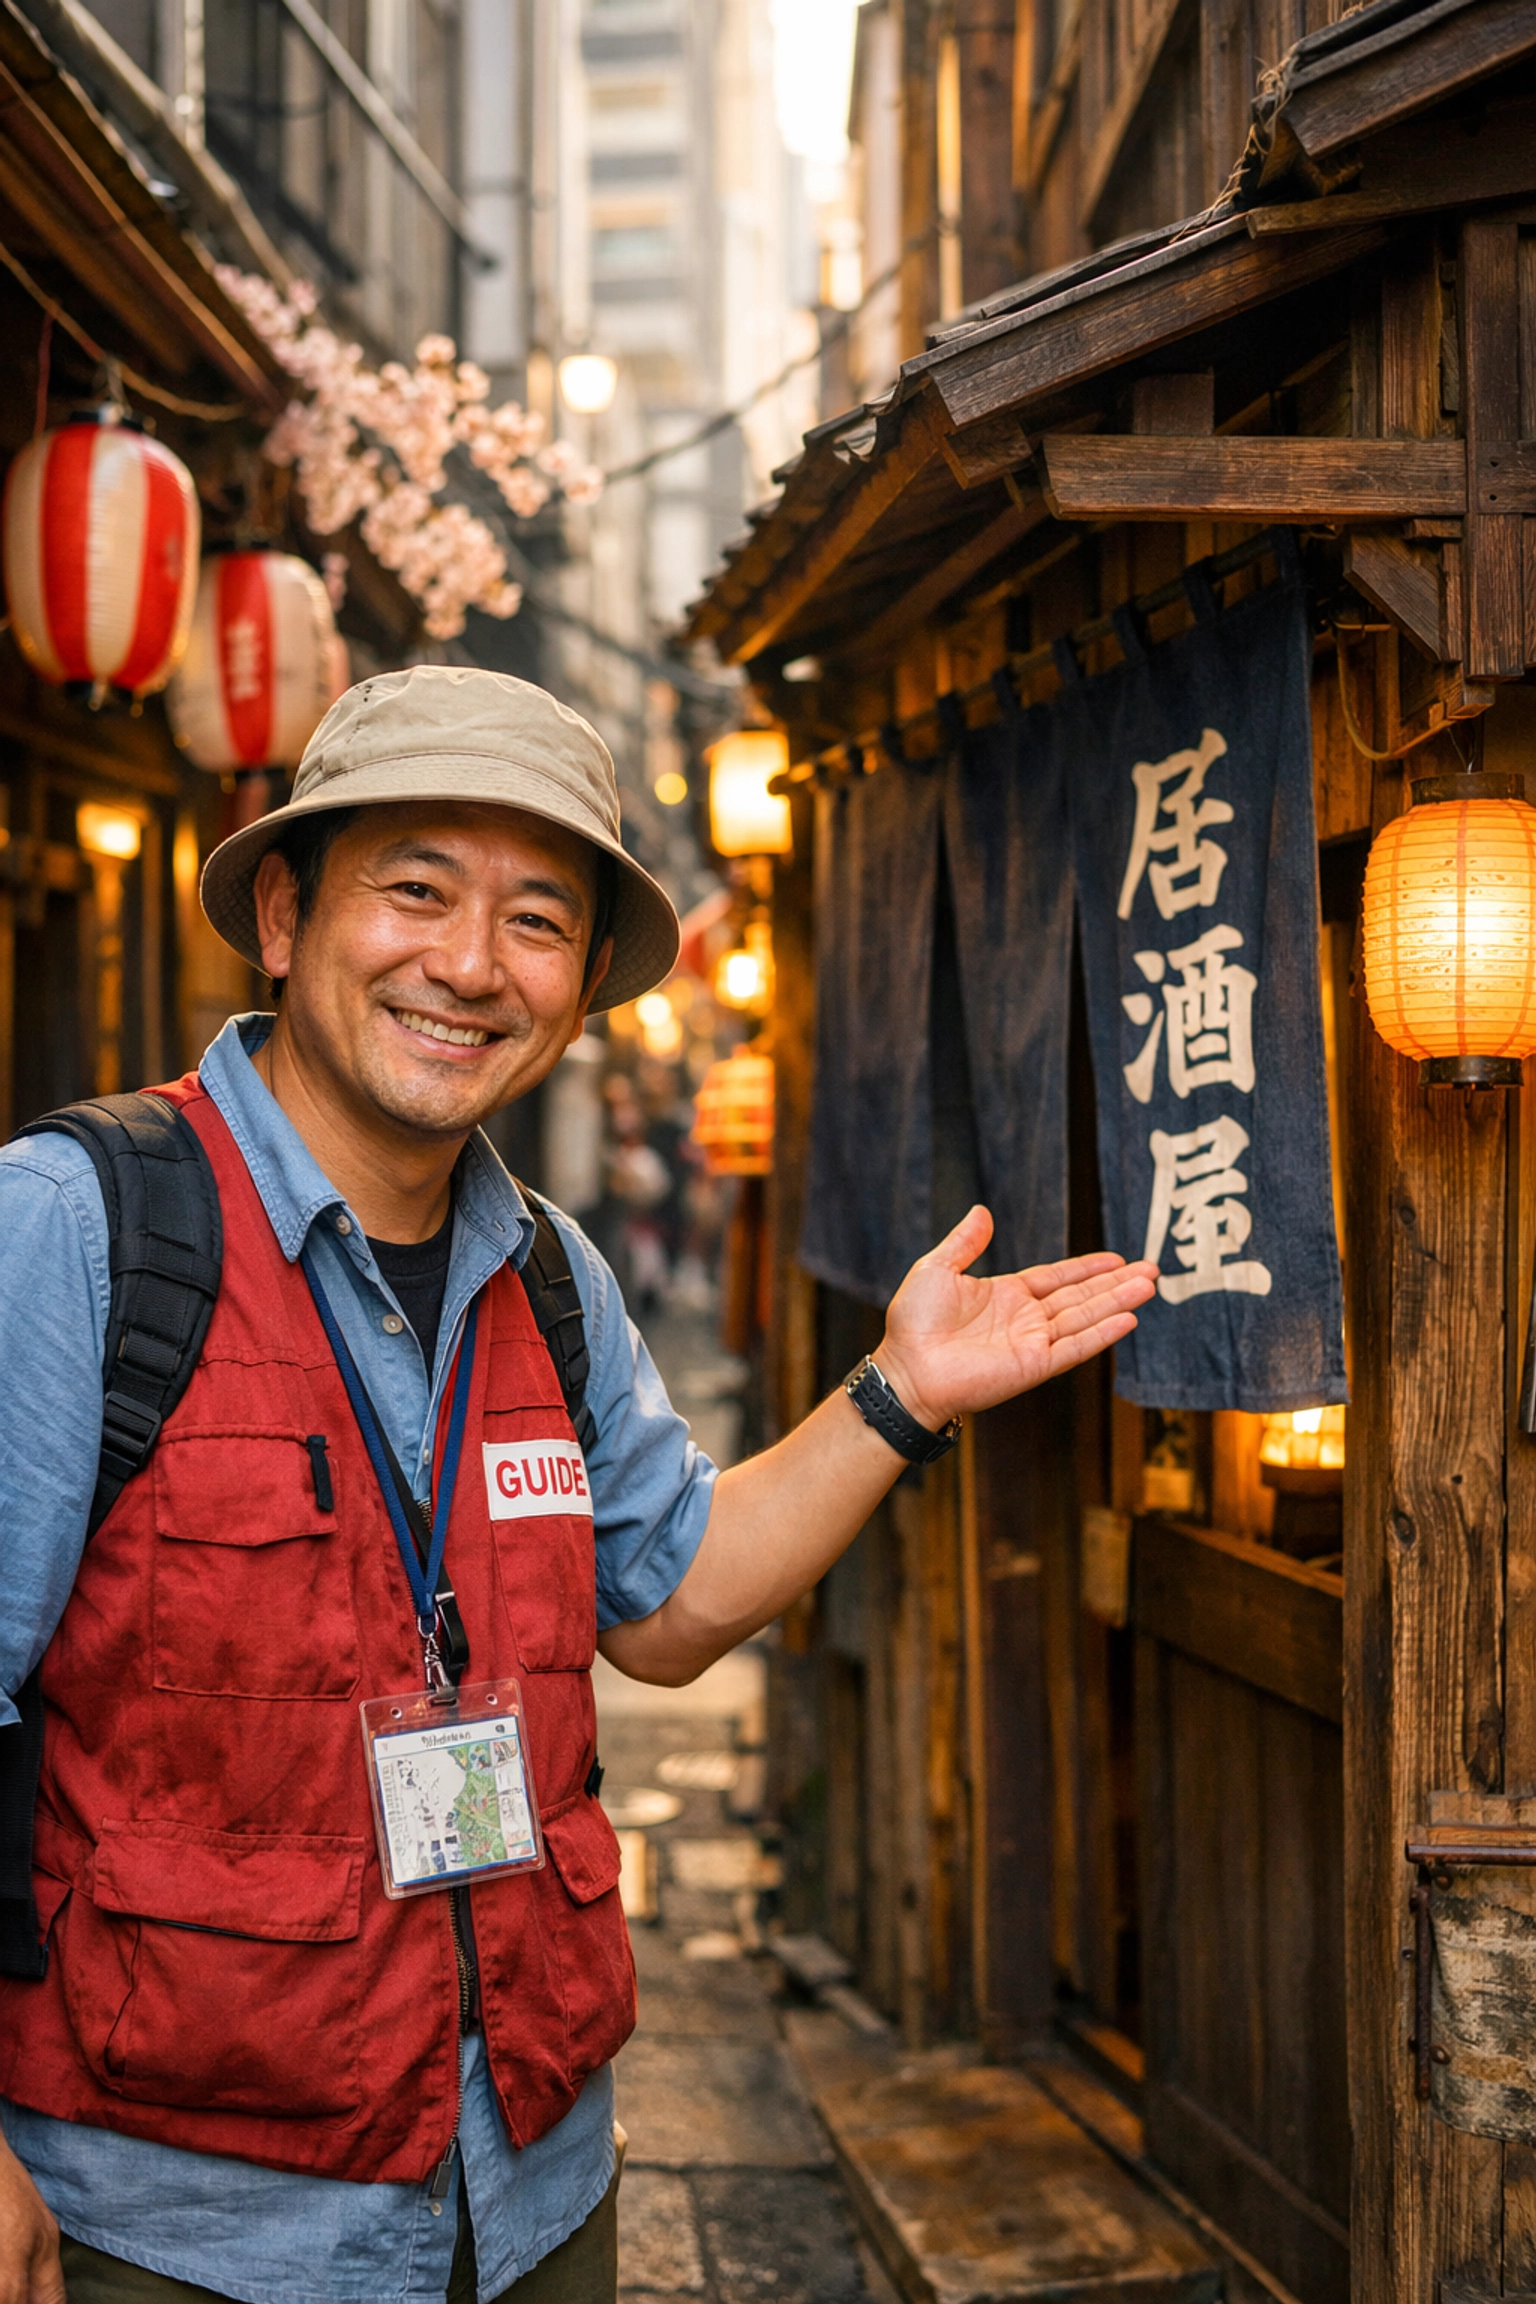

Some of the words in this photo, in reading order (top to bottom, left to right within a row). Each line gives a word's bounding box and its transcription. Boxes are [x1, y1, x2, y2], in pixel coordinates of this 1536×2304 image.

[1117, 727, 1272, 1304] 居酒屋
[495, 1456, 587, 1499] GUIDE
